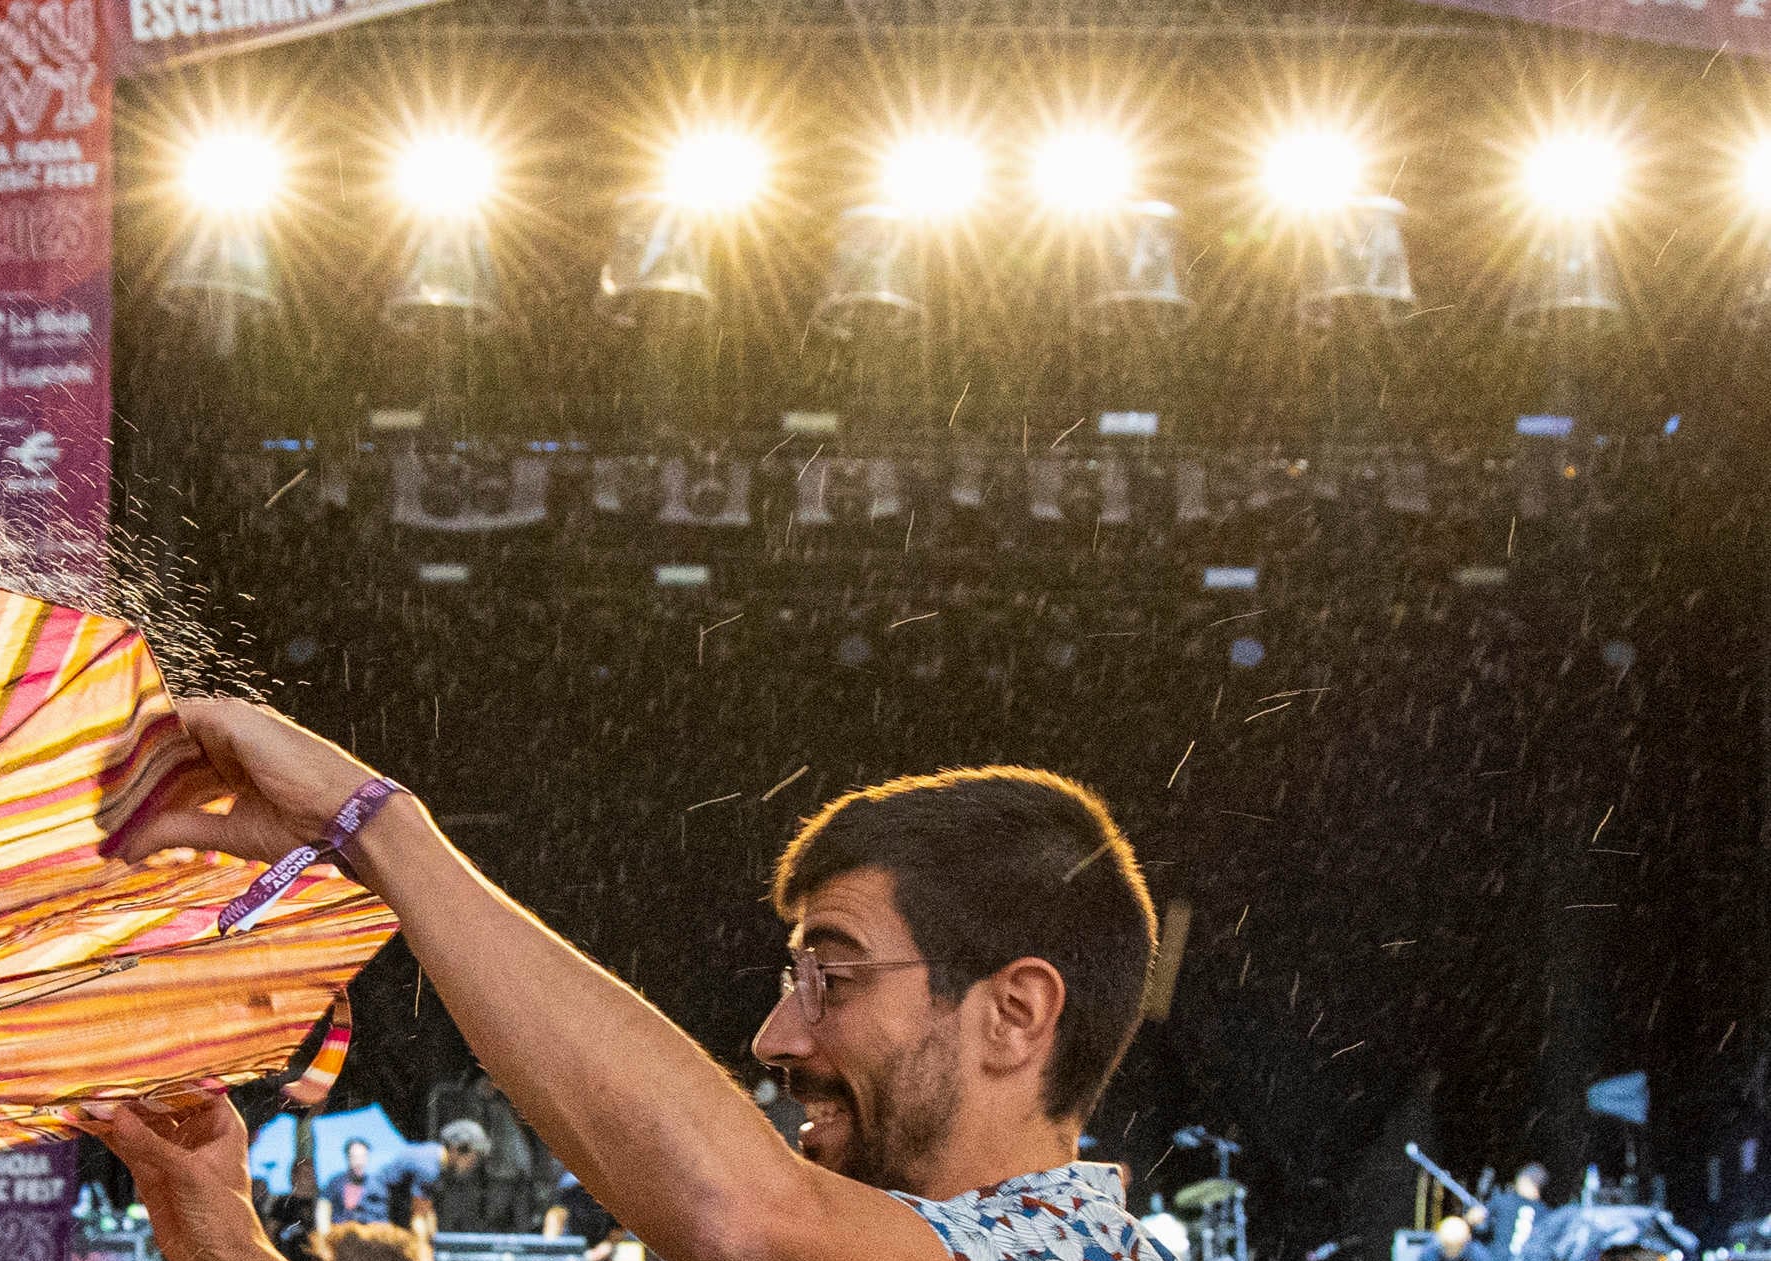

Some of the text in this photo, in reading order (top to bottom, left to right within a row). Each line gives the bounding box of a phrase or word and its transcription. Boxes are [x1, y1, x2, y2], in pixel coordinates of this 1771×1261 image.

[15, 139, 82, 162] RIOJA
[43, 163, 98, 187] FEST
[272, 851, 316, 889] ABONO
[14, 1178, 65, 1203] FEST
